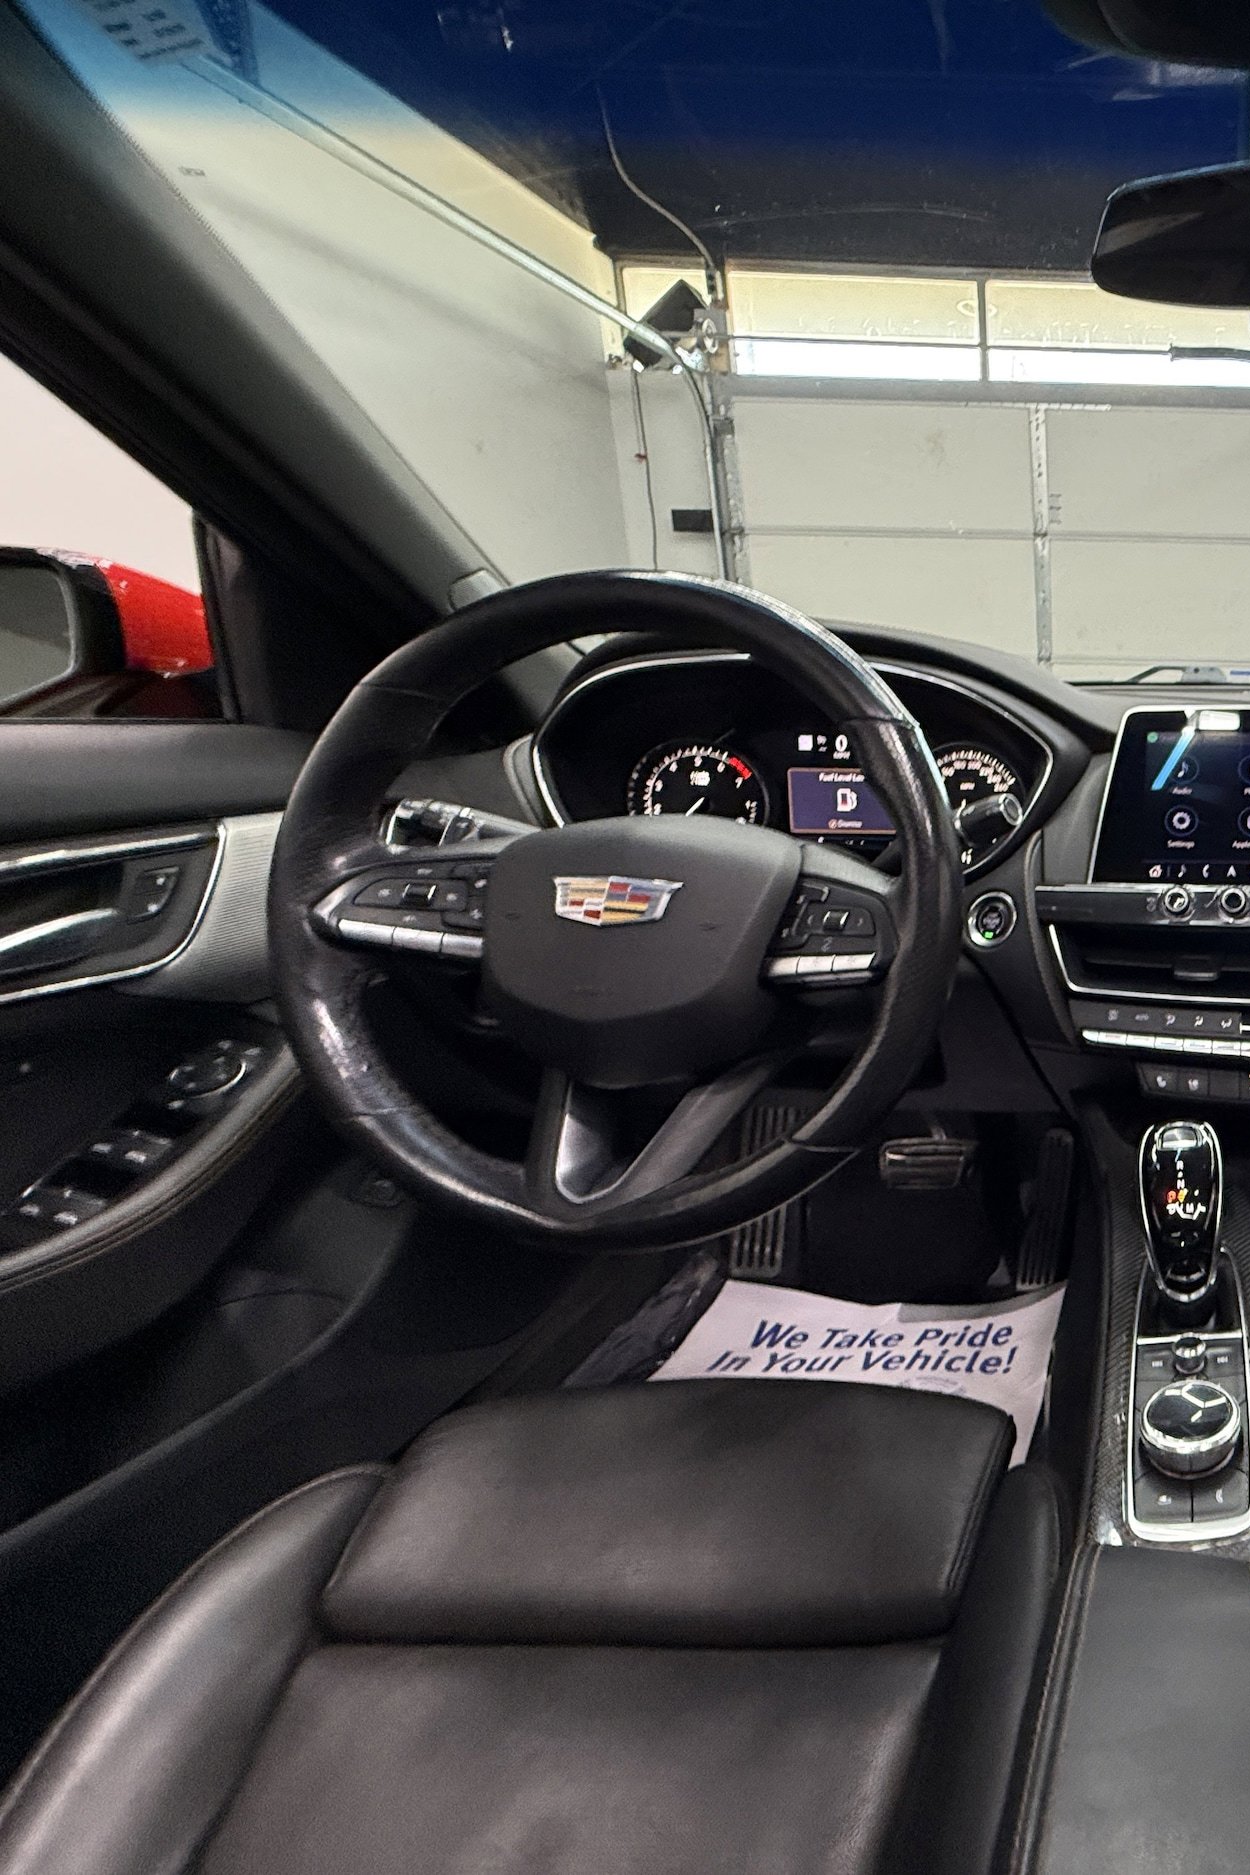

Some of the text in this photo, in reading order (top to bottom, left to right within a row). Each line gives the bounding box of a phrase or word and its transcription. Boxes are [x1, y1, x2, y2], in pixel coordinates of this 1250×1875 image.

[1167, 839, 1195, 849] Settings
[750, 1319, 1013, 1349] We Take Pride
[706, 1346, 1018, 1375] In Your Vehicle!
